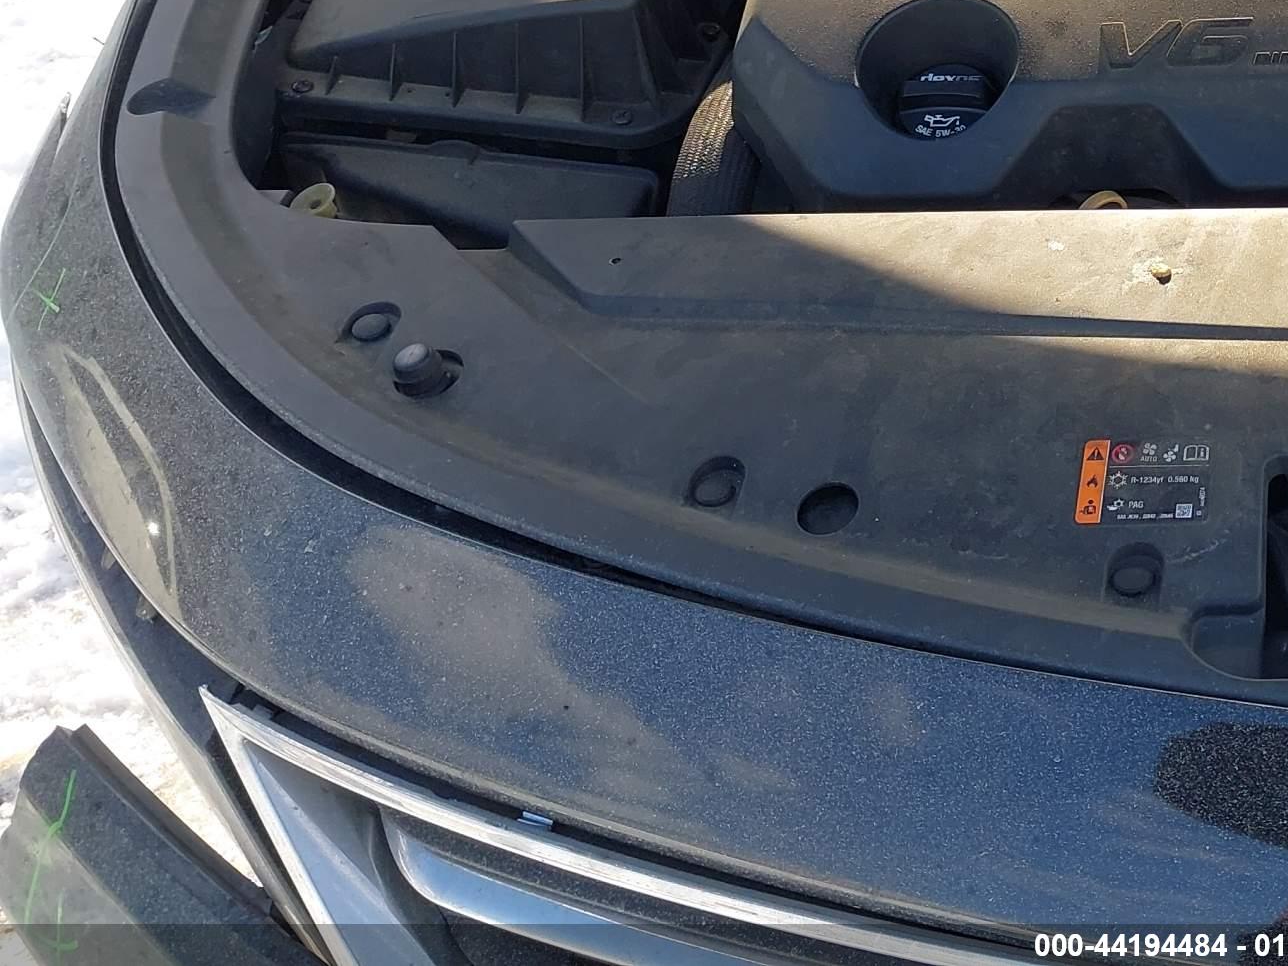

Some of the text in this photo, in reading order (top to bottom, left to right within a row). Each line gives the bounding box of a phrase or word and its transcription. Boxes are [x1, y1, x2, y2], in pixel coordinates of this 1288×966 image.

[1100, 16, 1254, 68] V6
[915, 124, 966, 138] SAE 5W-30
[1189, 475, 1200, 484] kg
[1128, 500, 1144, 509] PAG
